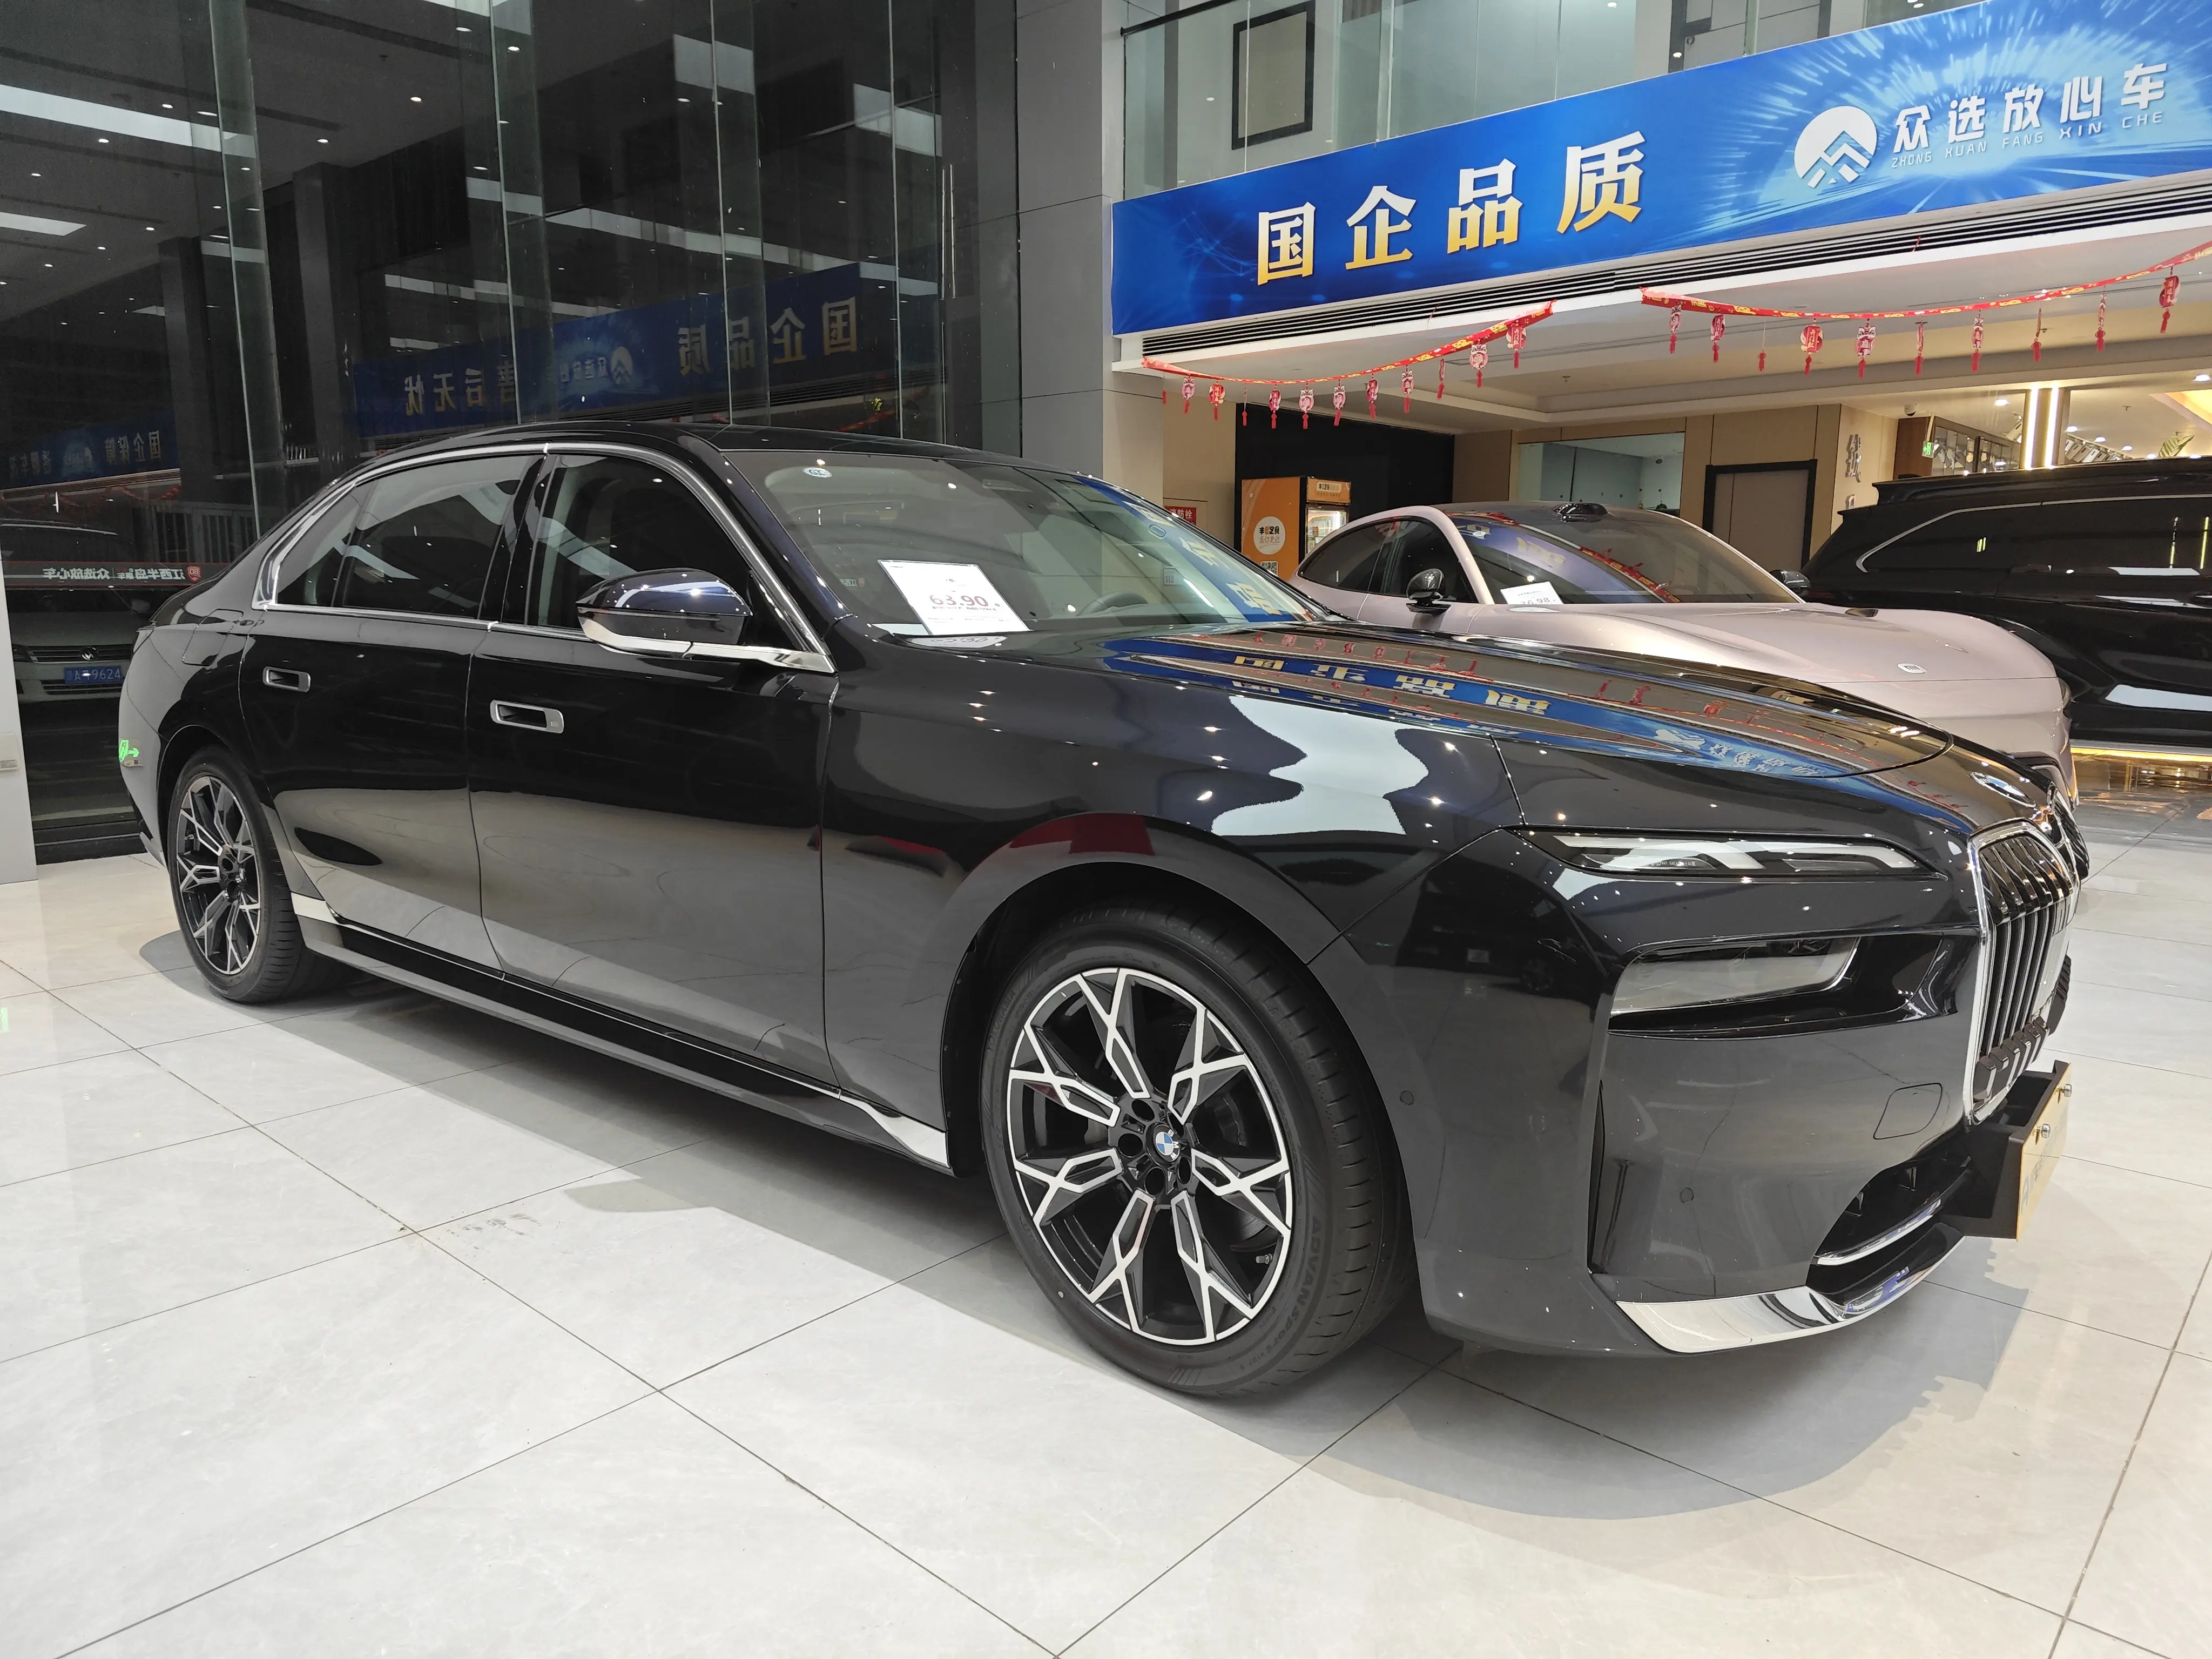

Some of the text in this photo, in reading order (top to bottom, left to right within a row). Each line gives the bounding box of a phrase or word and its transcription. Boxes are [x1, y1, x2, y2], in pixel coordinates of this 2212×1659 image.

[1893, 63, 2168, 153] 众选放心车
[1891, 111, 2162, 169] ZHONG XUAN FANG XIN CHE
[1257, 130, 1645, 286] 国企品质
[1808, 329, 1816, 348] 开门红
[929, 595, 989, 606] 63.90
[1168, 1129, 1179, 1160] BMW
[1297, 1215, 1321, 1309] ADVAN
